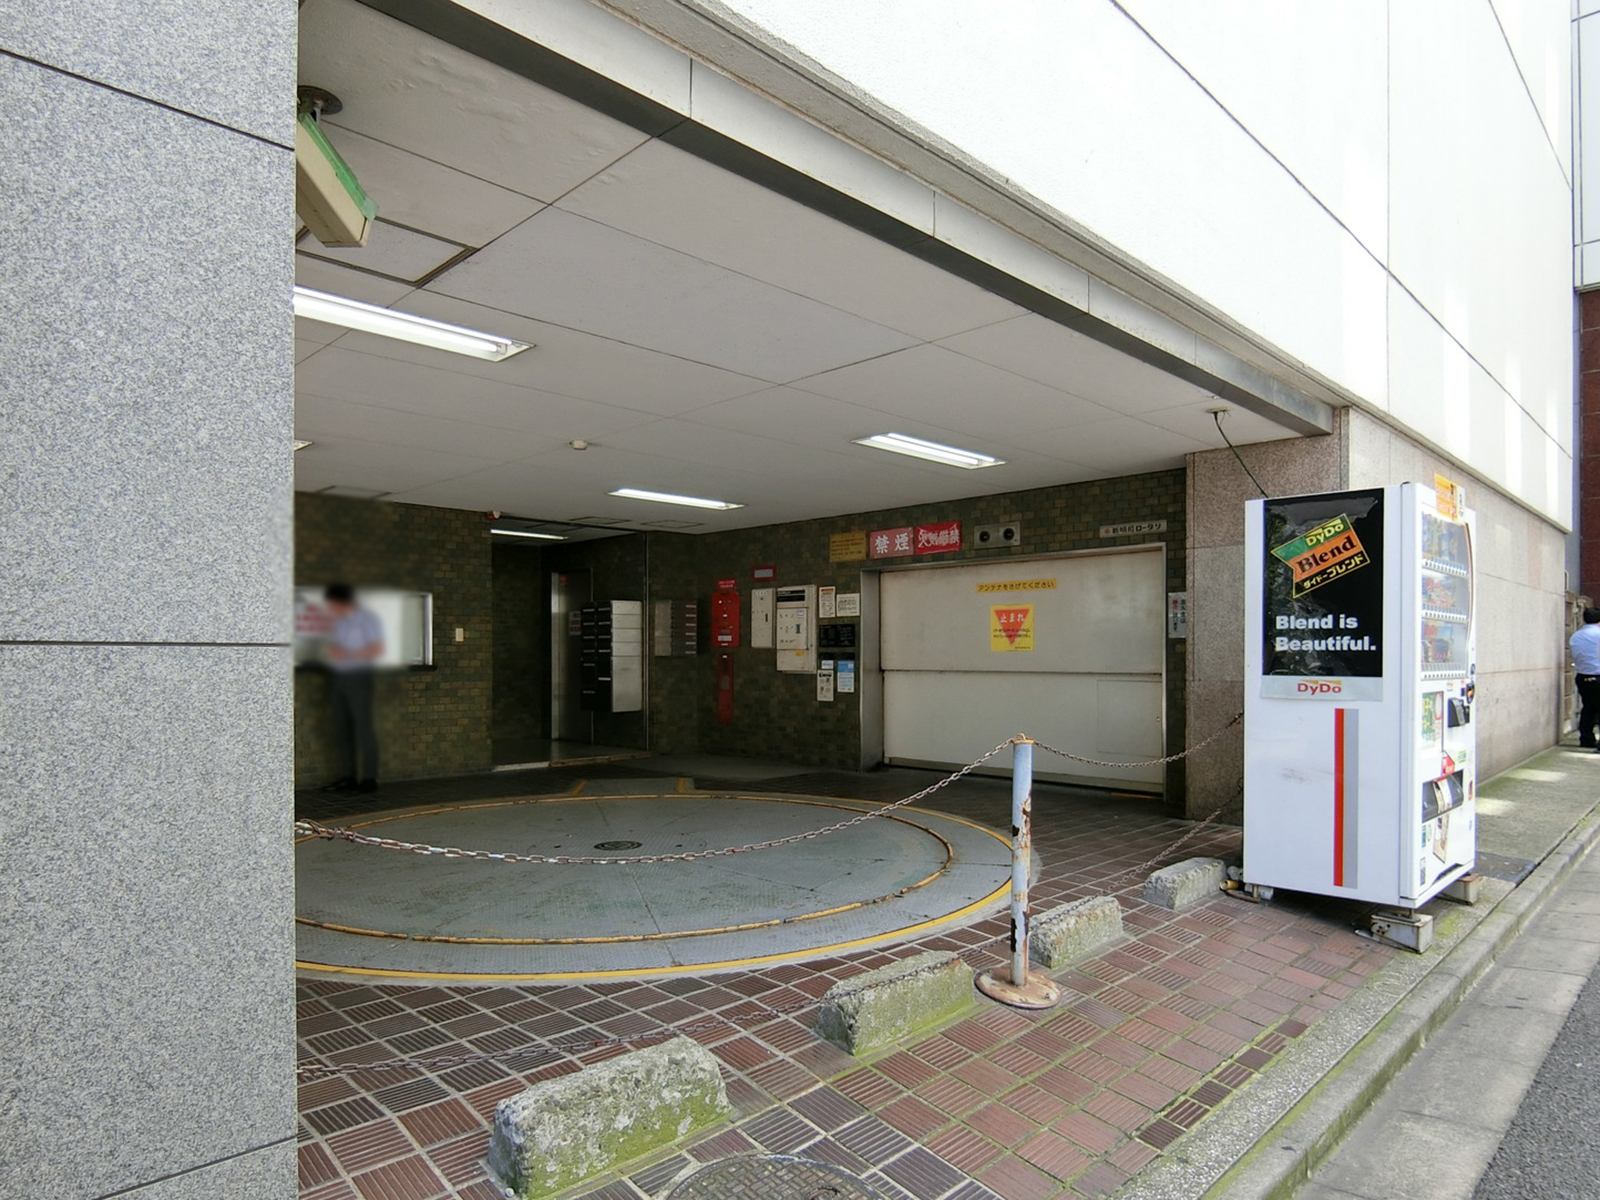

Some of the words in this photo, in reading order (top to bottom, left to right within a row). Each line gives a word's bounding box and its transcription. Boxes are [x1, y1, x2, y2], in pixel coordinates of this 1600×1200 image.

[1305, 519, 1345, 547] DyDo
[875, 532, 910, 554] 禁煙
[1295, 535, 1357, 574] Blend
[1303, 553, 1365, 589] ダイドーブレンド
[978, 581, 1055, 592] アンテナをさげてください
[999, 612, 1026, 624] 止まれ
[1275, 614, 1333, 630] Blend
[1339, 614, 1358, 630] is
[1275, 635, 1377, 652] Beautiful.
[1297, 681, 1342, 696] DyDo
